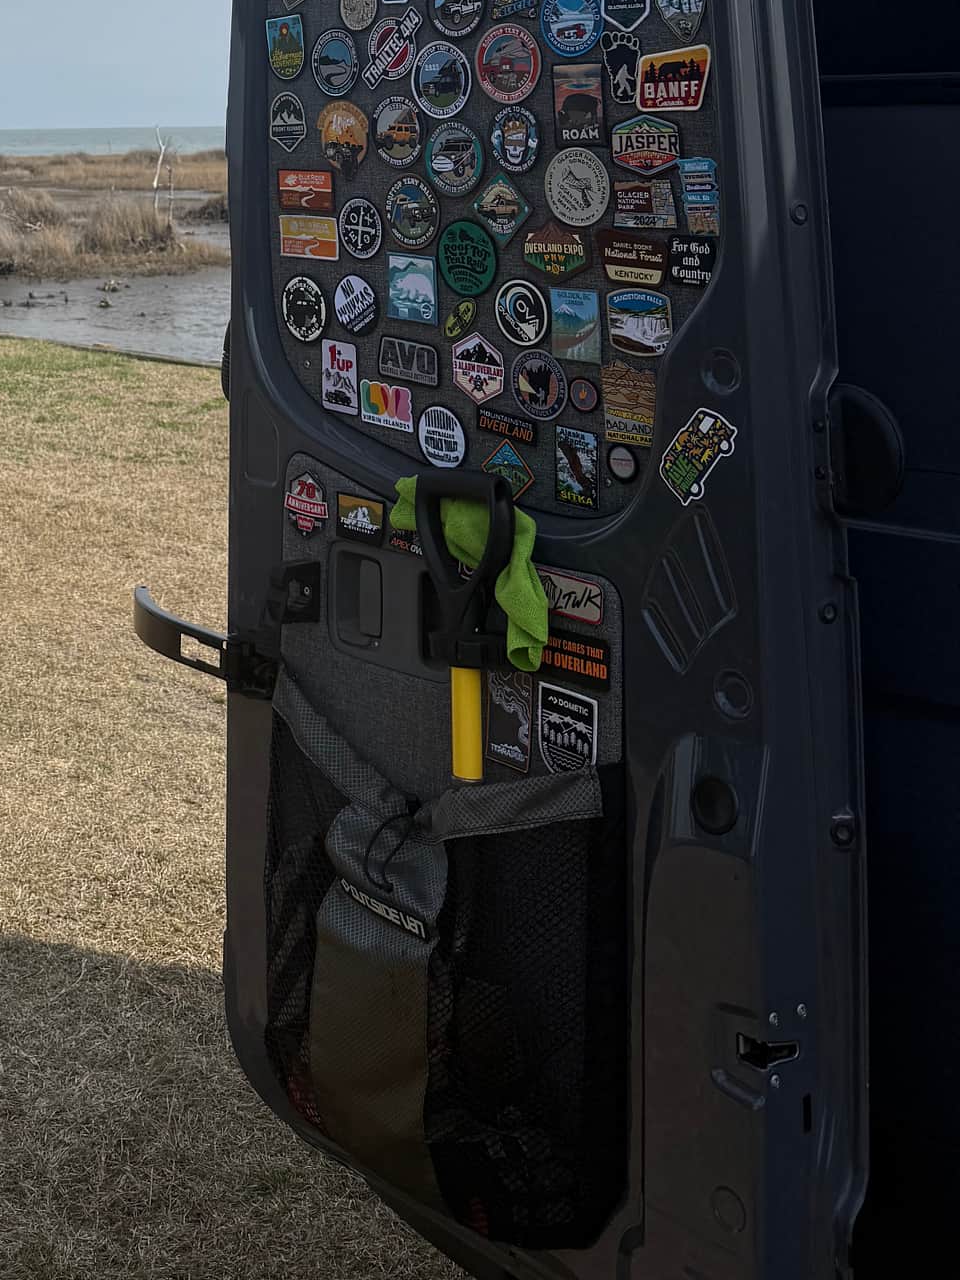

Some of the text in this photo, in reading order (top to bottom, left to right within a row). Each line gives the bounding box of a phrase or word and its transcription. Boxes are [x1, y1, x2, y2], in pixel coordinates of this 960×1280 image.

[482, 27, 535, 49] ROOFTOP TENT RALLY
[547, 32, 597, 52] CANADIAN ROCKIES
[365, 32, 401, 84] TRAILTEC
[401, 12, 419, 38] 4X4
[418, 45, 464, 65] ROOFTOP TENT RALLY
[644, 81, 699, 99] BANFF
[373, 97, 390, 119] ROOFTOP
[403, 98, 419, 113] RALLY
[494, 107, 511, 122] ESCAPE
[562, 128, 600, 140] ROAM
[614, 135, 679, 154] JASPER
[558, 151, 582, 163] GLACIER
[583, 153, 605, 182] NATIONAL
[386, 177, 434, 211] ROOFTOP TENT RALLY
[617, 191, 649, 199] GLACIER
[633, 215, 657, 226] 2024
[524, 242, 584, 257] OVERLAND EXPO
[671, 238, 710, 255] For God
[604, 248, 663, 264] National Forest
[683, 256, 700, 266] and
[614, 270, 654, 281] KENTUCKY
[671, 267, 712, 283] Country
[340, 278, 355, 299] NO
[613, 294, 663, 304] SANDSTONE FALLS
[498, 305, 528, 341] OVERLAND
[382, 339, 433, 375] AVO
[458, 361, 503, 377] ALARM OVERLAND
[363, 414, 410, 430] VIRGIN ISLANDS
[480, 416, 534, 443] OVERLAND
[607, 420, 654, 434] BADLAND
[560, 428, 585, 440] Alaska
[560, 435, 590, 448] Raptor
[607, 432, 637, 441] NATIONAL
[297, 480, 316, 498] 70
[287, 494, 325, 516] ANNIVERSARY
[560, 490, 593, 506] SITKA
[390, 537, 410, 551] APEX
[562, 639, 604, 660] CARES THAT
[553, 652, 608, 680] OVERLAND
[558, 699, 590, 717] DOMETIC
